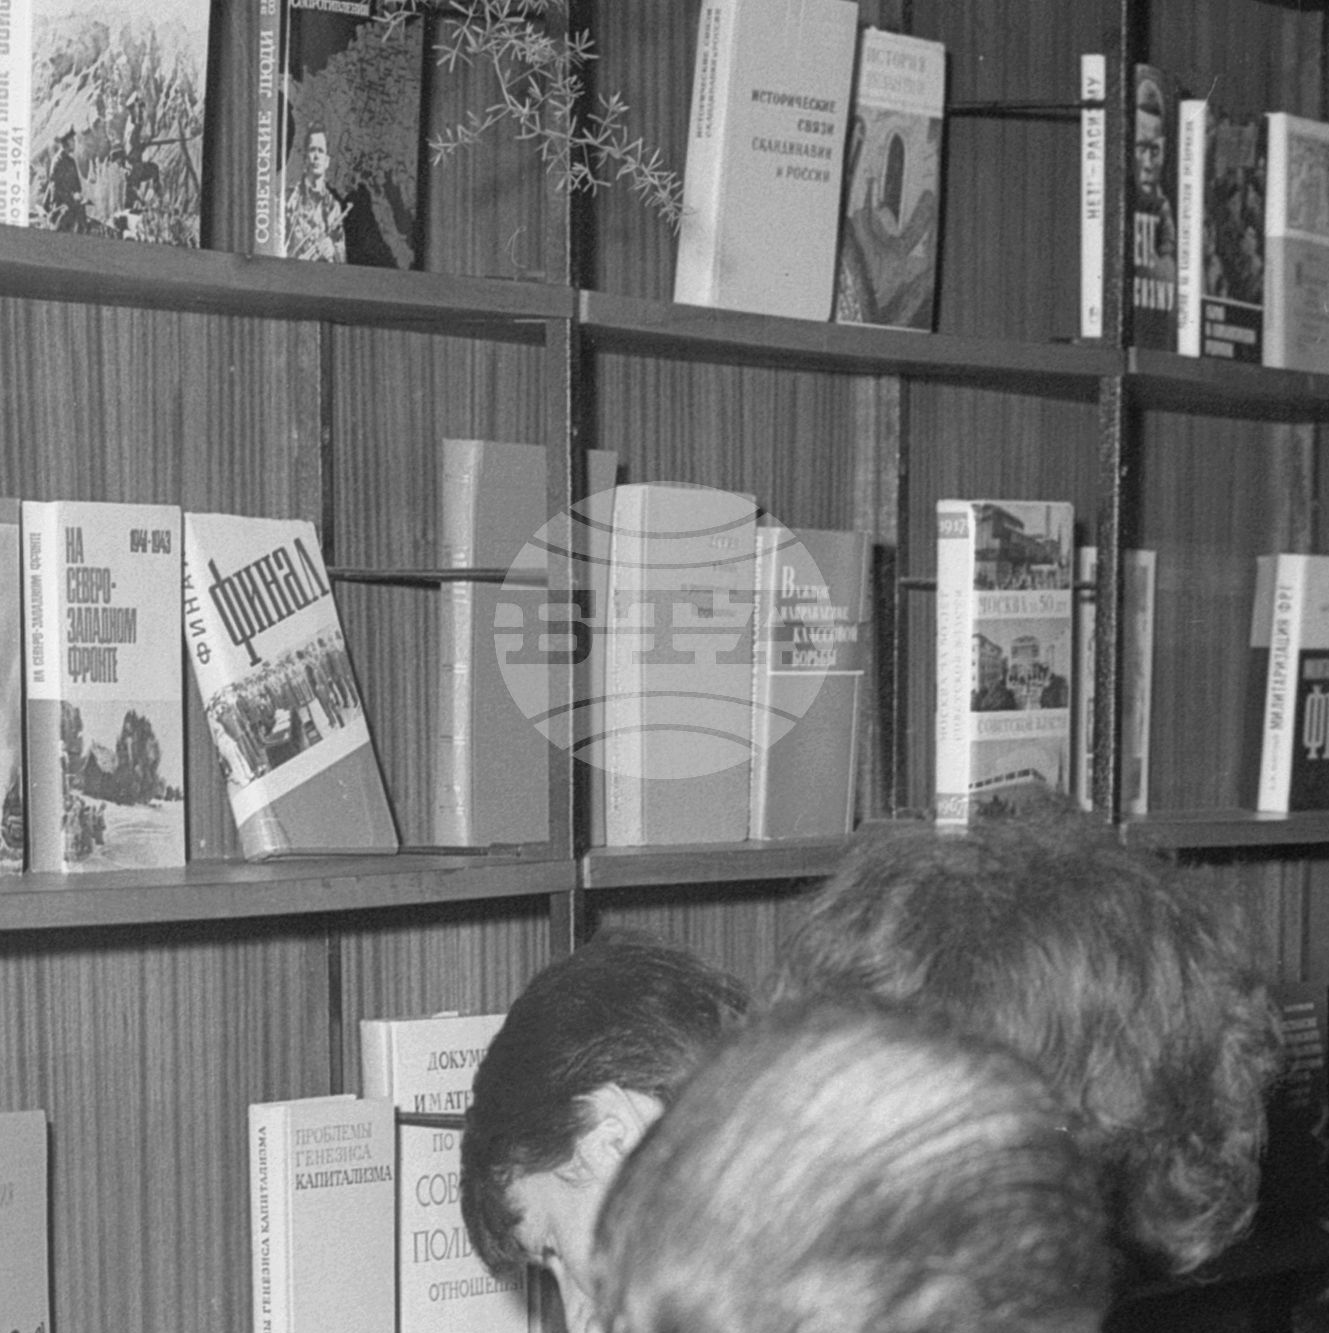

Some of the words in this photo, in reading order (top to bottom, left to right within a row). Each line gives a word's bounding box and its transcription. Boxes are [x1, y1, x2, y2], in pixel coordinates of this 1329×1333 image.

[258, 30, 275, 98] ЛЮДИ
[1087, 75, 1102, 161] РАСИМУ
[255, 110, 272, 243] СОВЕТСКИЕ
[65, 527, 84, 564] НА
[66, 567, 116, 604] СЕВЕРО-
[67, 607, 137, 644] ЗАПАДНОМ
[183, 560, 211, 665] ФИНА
[68, 645, 118, 683] ФРОНТЕ
[427, 1050, 487, 1072] ДОКУМ
[429, 1089, 474, 1112] МАТЕ
[296, 1122, 372, 1146] ПРОБЛЕМЫ
[433, 1133, 454, 1152] ПО
[296, 1144, 372, 1168] ГЕНЕЗИСА
[258, 1125, 270, 1233] КАПИТАЛИЗМА
[296, 1165, 393, 1190] КАПИТАЛИЗМА
[416, 1172, 460, 1206] СОВ
[413, 1227, 473, 1263] ПОЛЬ
[260, 1238, 271, 1314] ГЕНЕЗИСА
